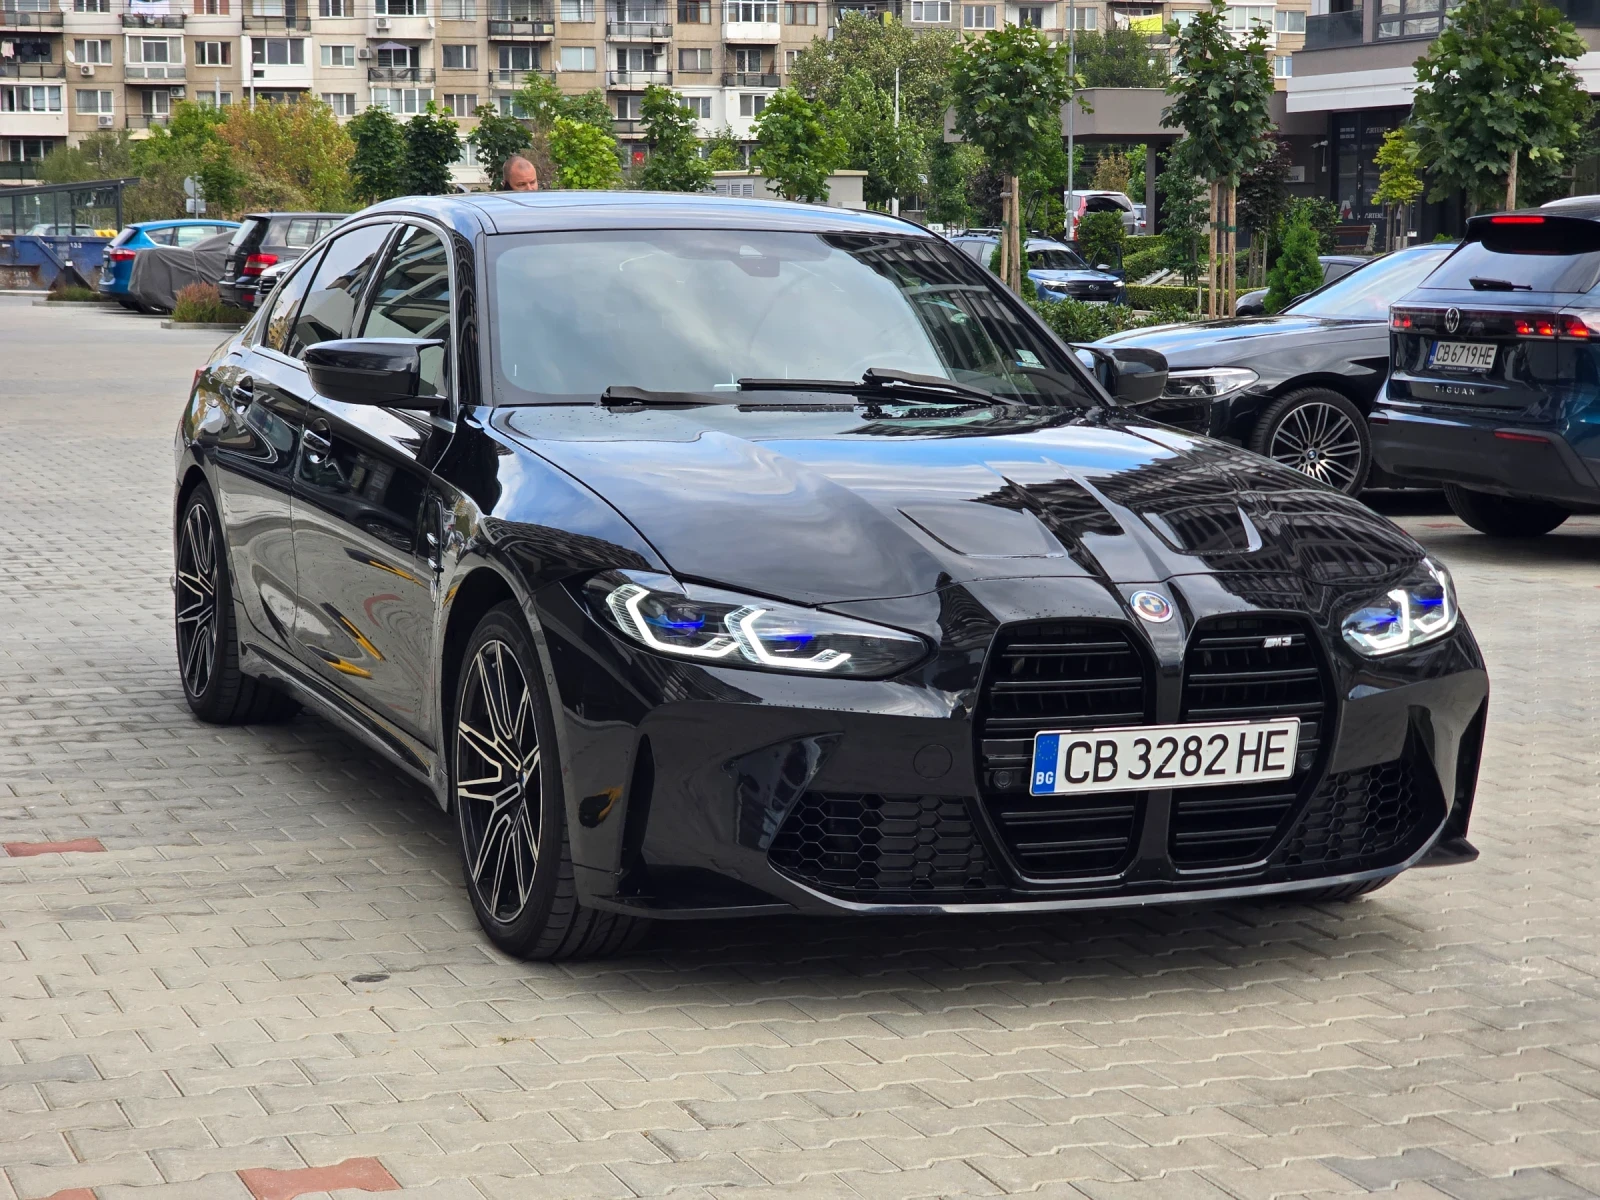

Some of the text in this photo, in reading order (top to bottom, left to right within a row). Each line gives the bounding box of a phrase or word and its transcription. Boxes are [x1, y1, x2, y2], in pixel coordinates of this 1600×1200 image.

[1436, 344, 1495, 365] CB 6719 HE
[1434, 385, 1475, 396] TIGUAN
[1064, 729, 1289, 783] CB 3282 HE
[1035, 771, 1055, 785] BG
